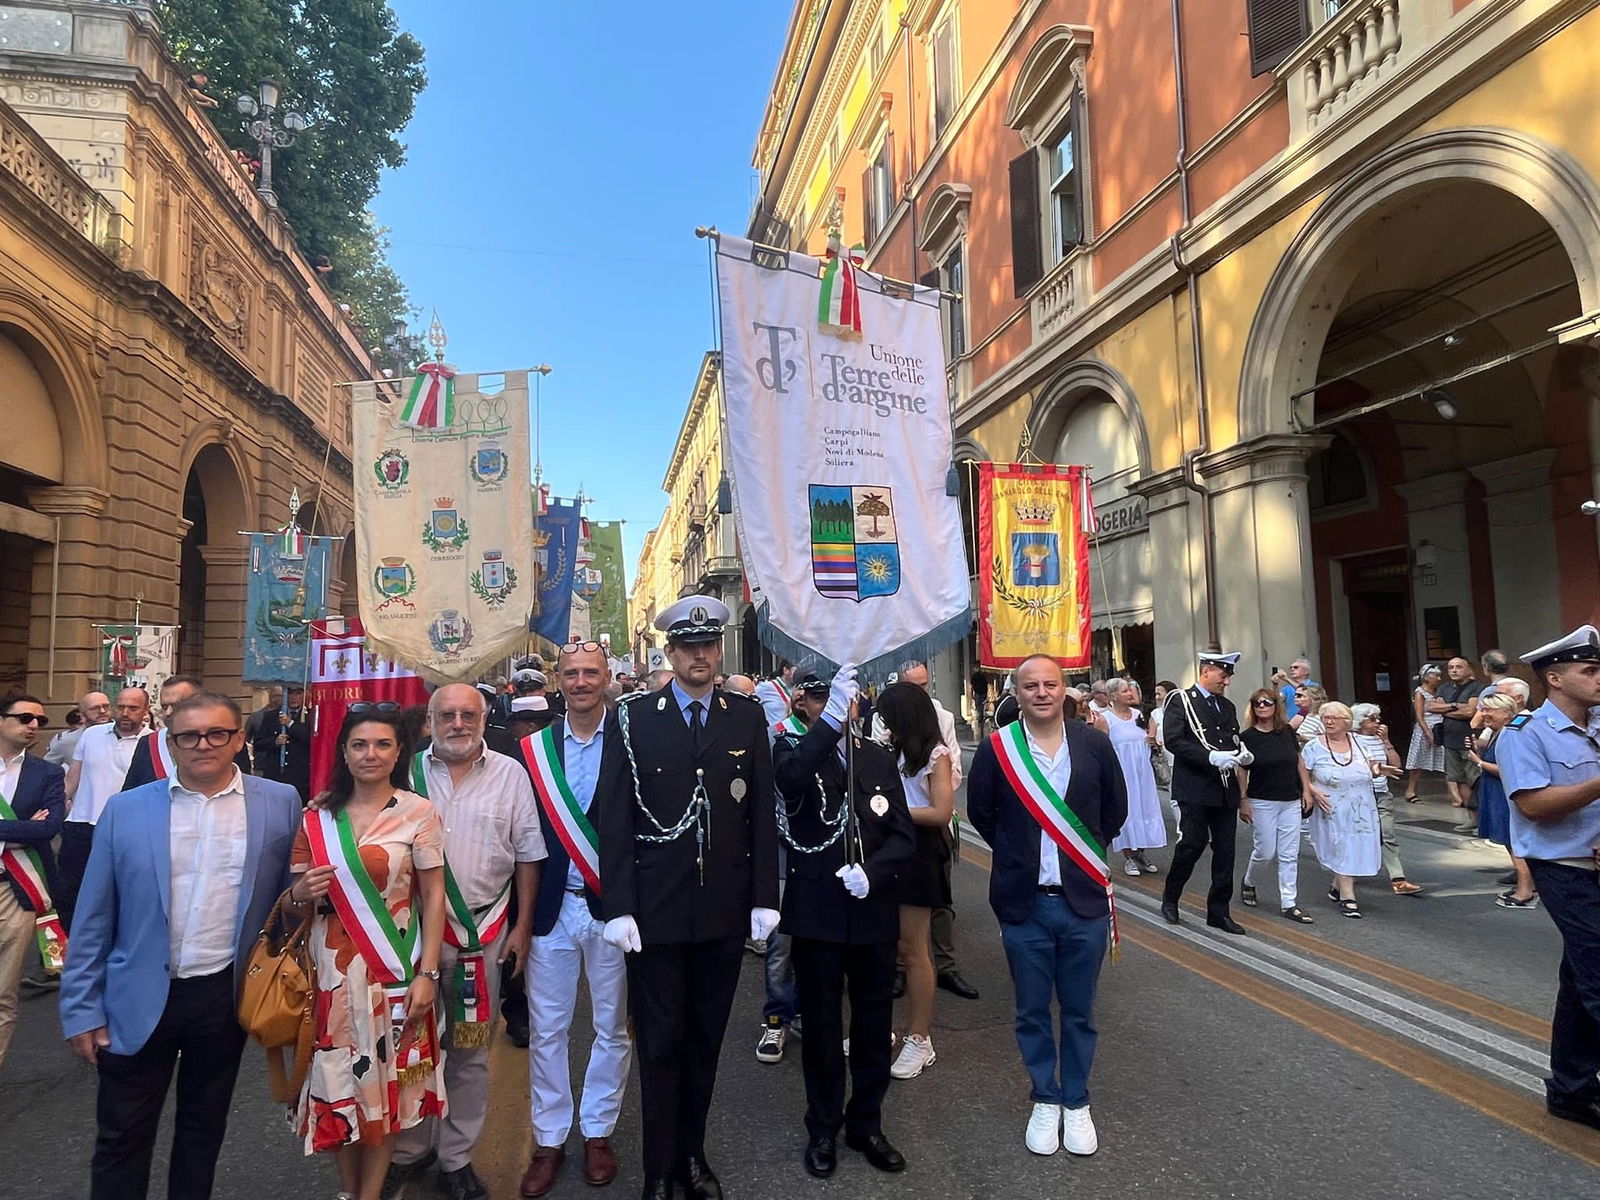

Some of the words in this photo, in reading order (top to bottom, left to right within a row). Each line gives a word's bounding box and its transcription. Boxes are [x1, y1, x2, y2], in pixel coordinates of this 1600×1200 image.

[868, 343, 923, 369] Unione
[820, 353, 893, 390] Terre
[891, 366, 925, 386] delle
[822, 381, 928, 417] d'argine
[824, 426, 881, 437] Campogalliano
[824, 436, 849, 447] Carpi
[825, 447, 843, 456] Novi
[845, 448, 854, 456] di
[856, 448, 884, 458] Modena
[825, 457, 854, 467] Soliera
